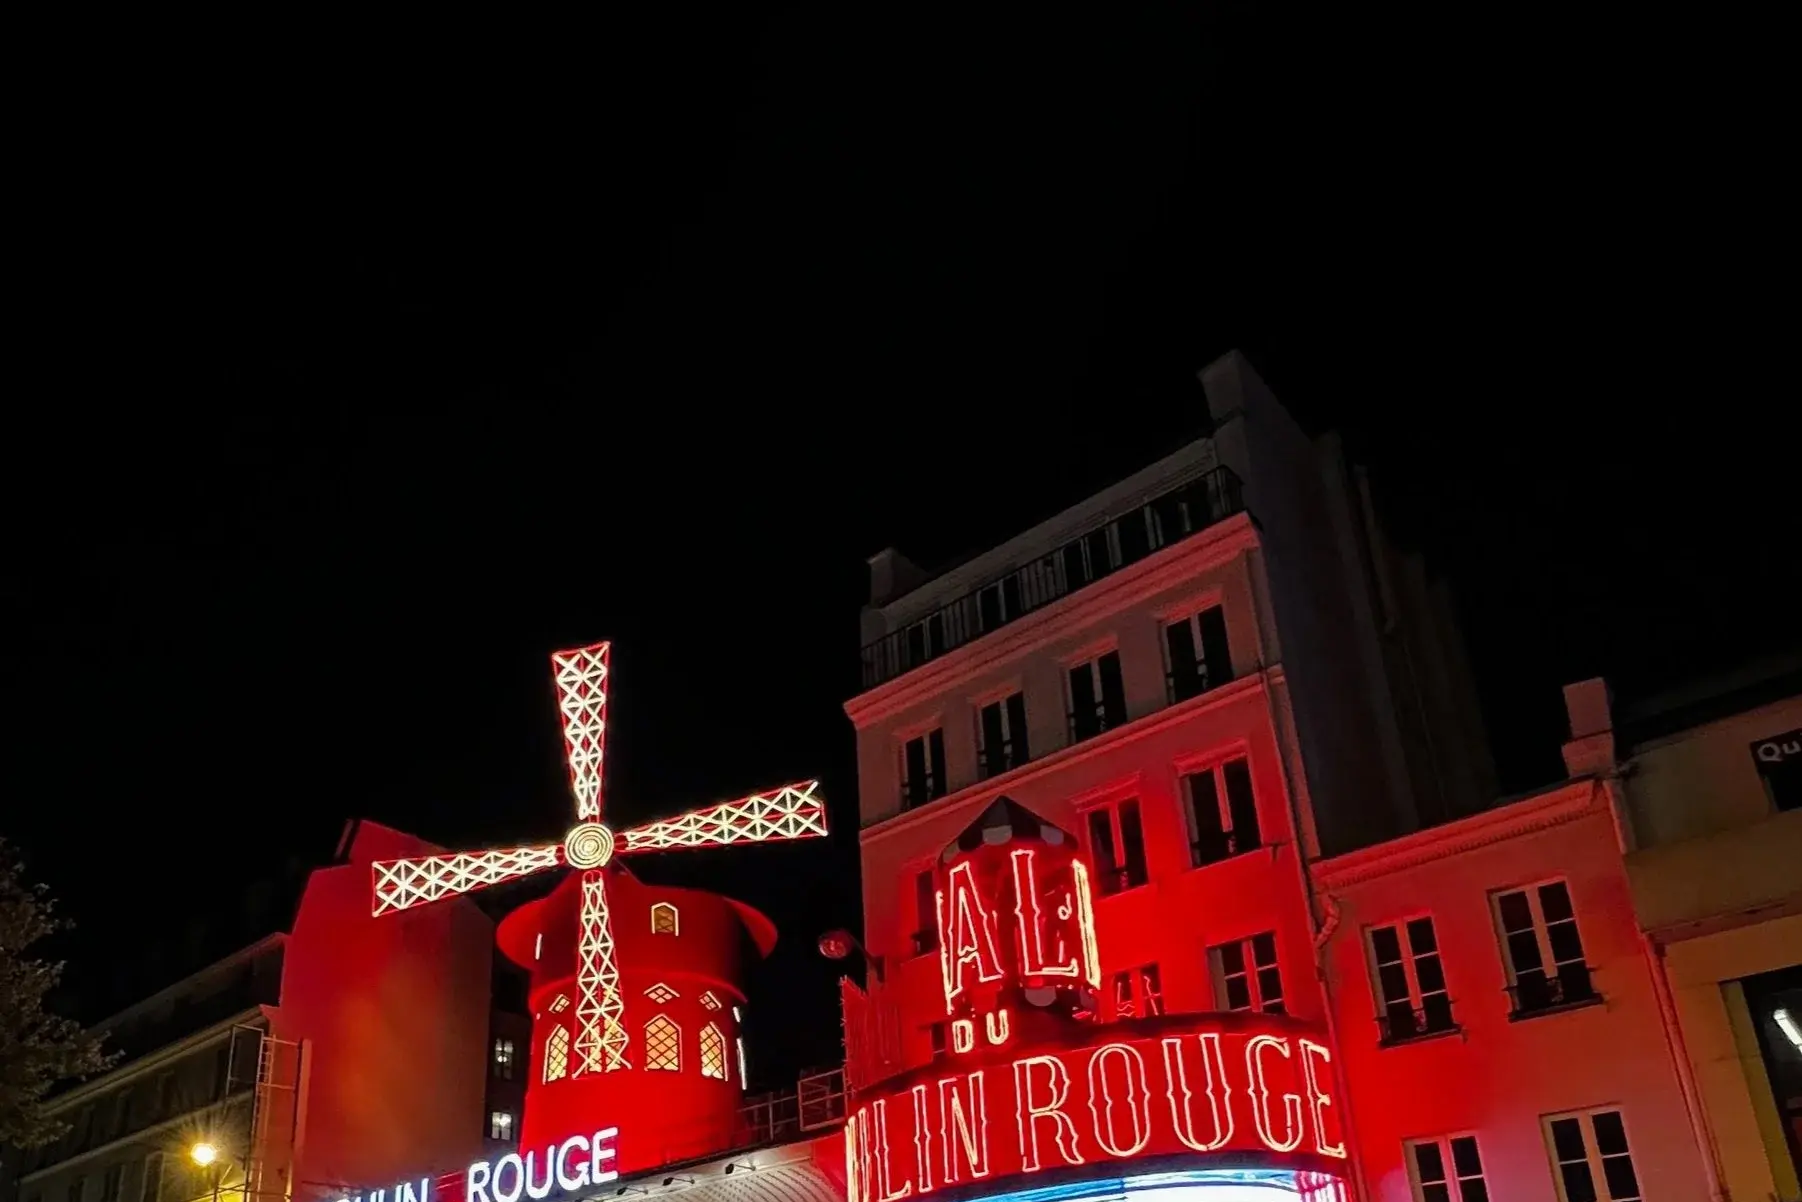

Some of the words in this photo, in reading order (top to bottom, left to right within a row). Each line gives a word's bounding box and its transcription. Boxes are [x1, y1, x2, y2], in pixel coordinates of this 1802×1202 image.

[1757, 738, 1802, 762] Qu
[952, 1009, 1010, 1054] DU
[1013, 1033, 1348, 1173] ROUGE
